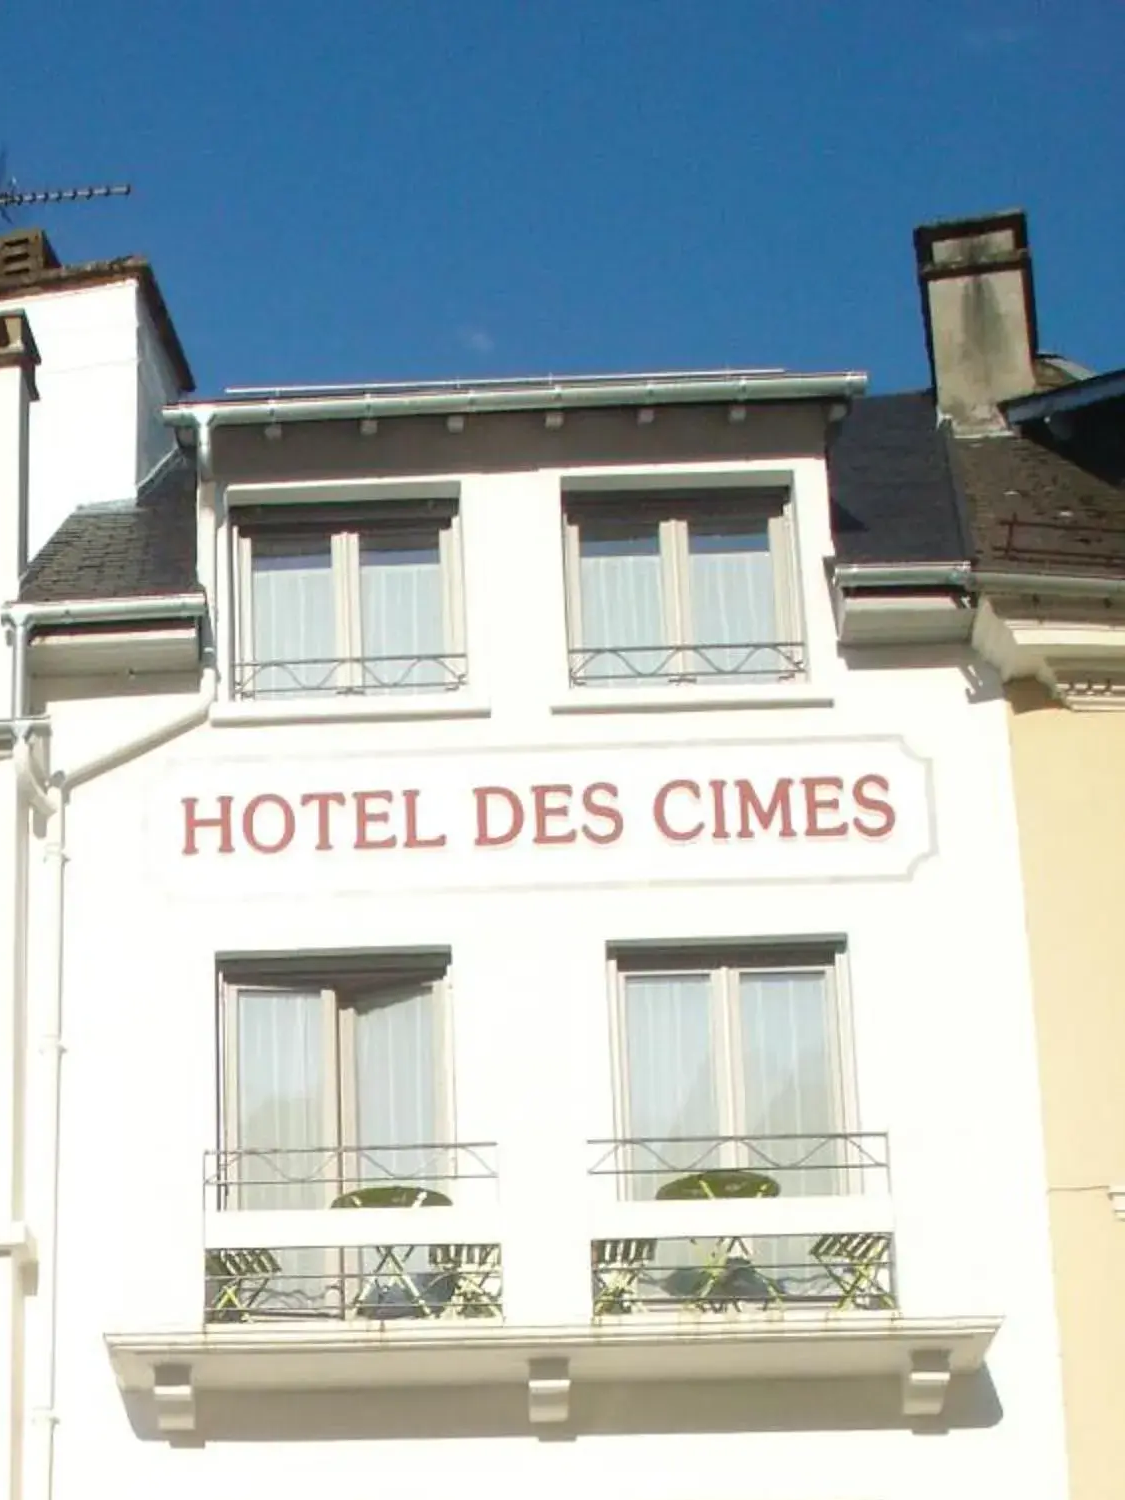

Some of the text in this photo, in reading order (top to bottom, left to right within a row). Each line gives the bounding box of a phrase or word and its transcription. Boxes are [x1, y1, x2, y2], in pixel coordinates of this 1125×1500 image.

[181, 774, 896, 856] HOTEL DES CIMES
